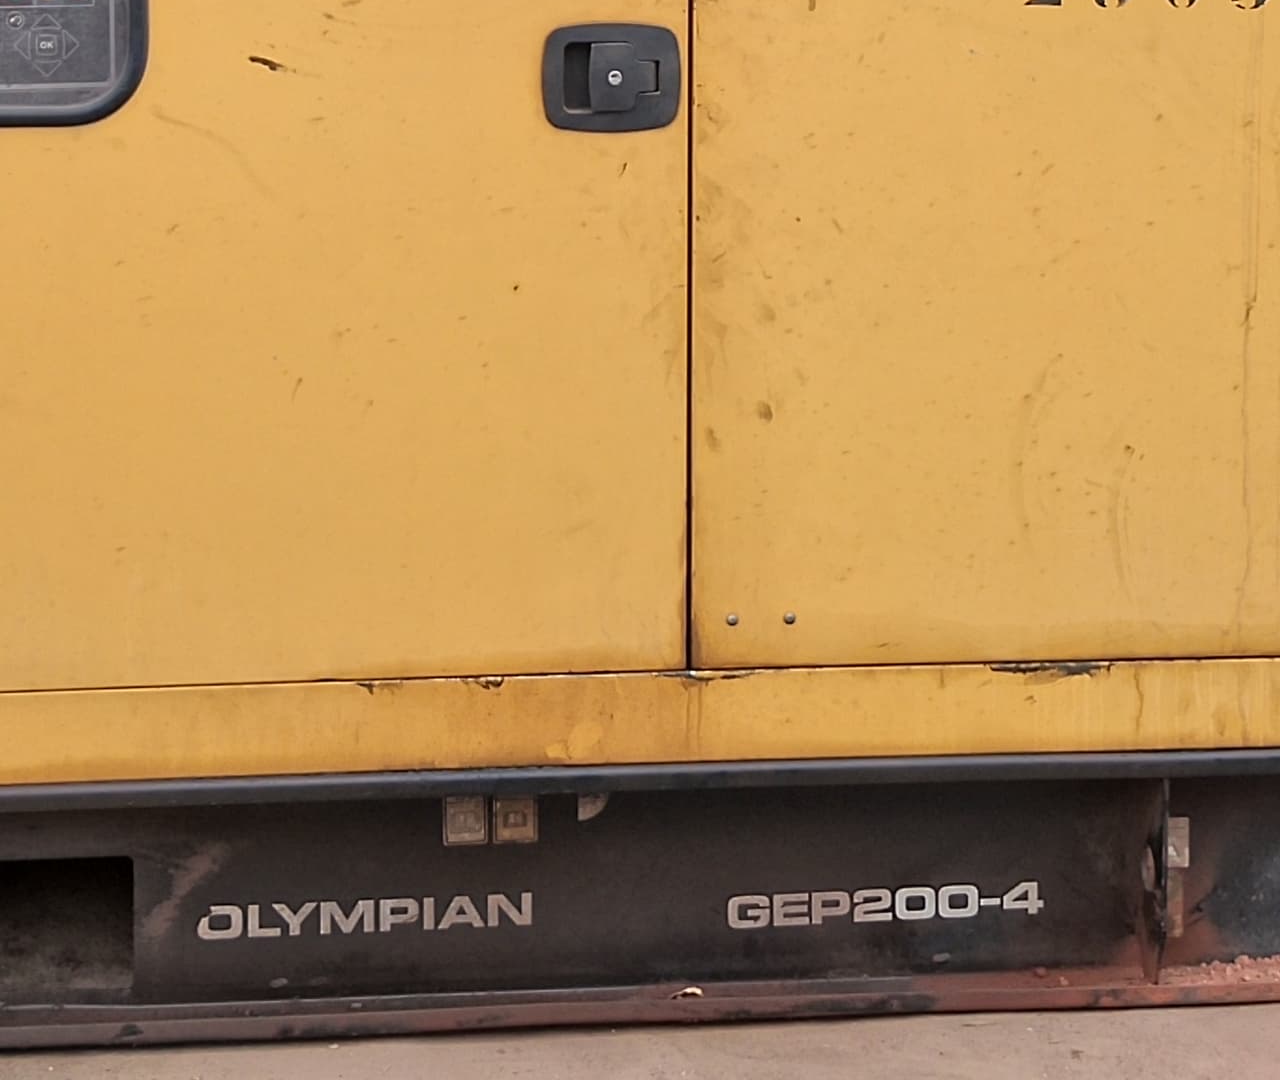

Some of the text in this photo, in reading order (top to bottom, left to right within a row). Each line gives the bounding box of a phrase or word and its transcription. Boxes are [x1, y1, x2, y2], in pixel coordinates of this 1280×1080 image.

[39, 40, 54, 49] OK
[196, 891, 534, 941] OLYMPIAN
[727, 880, 1044, 930] GEP200-4
